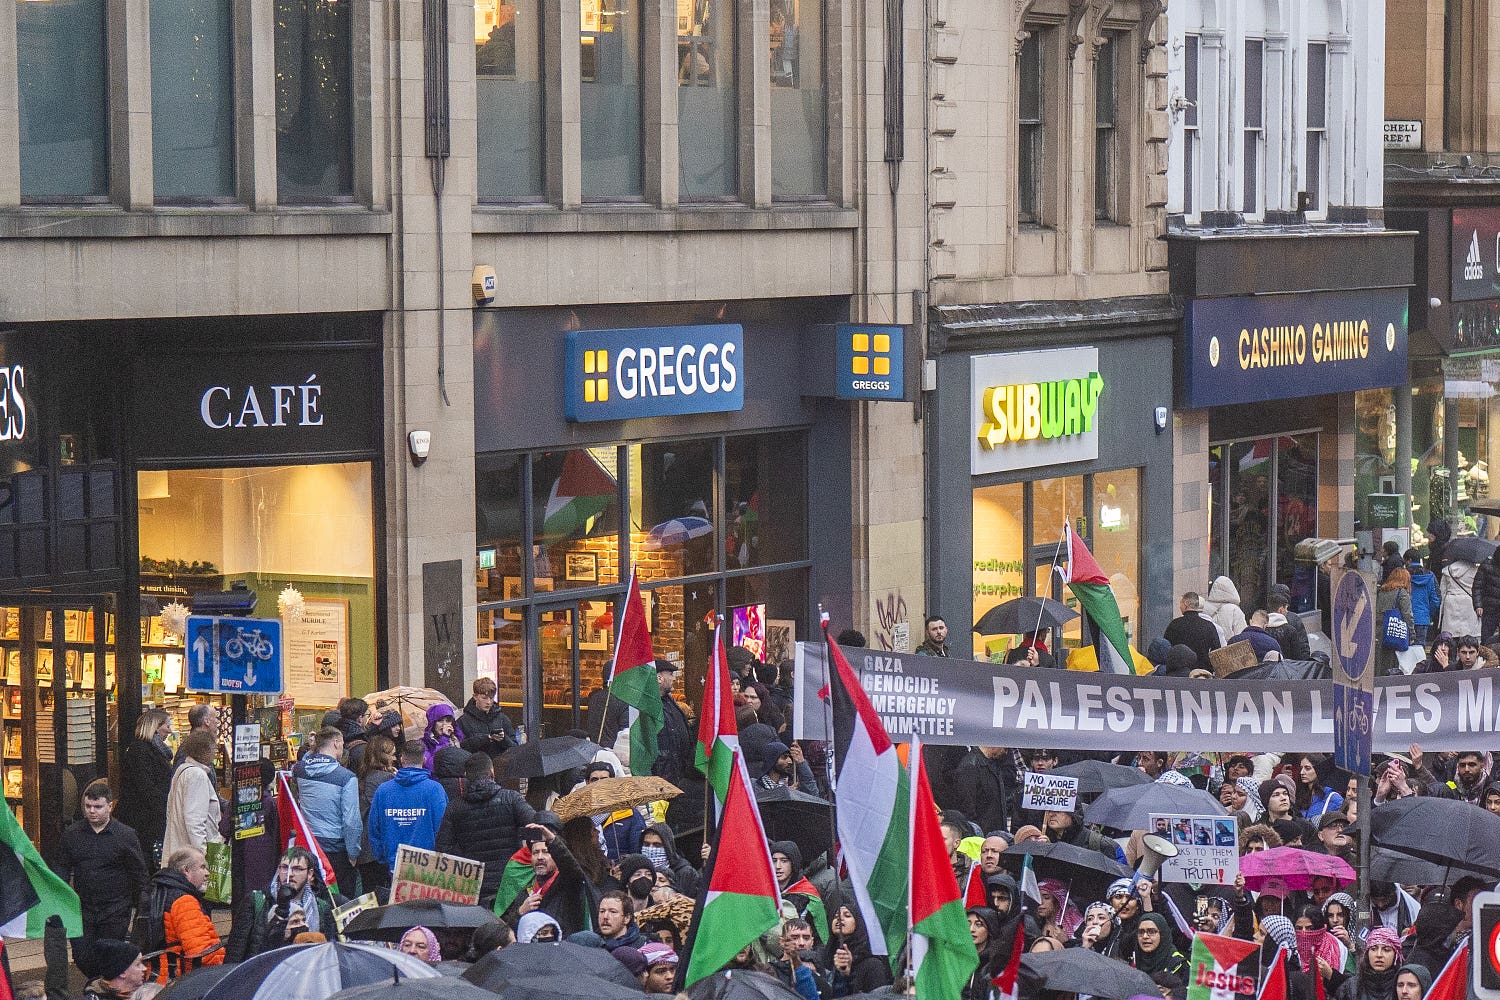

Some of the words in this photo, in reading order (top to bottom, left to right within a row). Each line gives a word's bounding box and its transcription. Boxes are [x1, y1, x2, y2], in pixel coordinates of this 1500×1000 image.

[1464, 261, 1483, 281] adidas
[1238, 324, 1307, 370] CASHINO
[1312, 319, 1369, 363] GAMING
[616, 342, 737, 400] GREGGS
[852, 380, 890, 391] GREGGS
[201, 374, 324, 429] CAFÉ
[978, 371, 1104, 450] SUBWAY
[163, 585, 188, 595] thinking
[863, 655, 904, 673] GAZA
[864, 674, 939, 695] GENOCIDE
[992, 676, 1294, 735] PALESTINIAN
[1310, 683, 1441, 735] LES
[878, 716, 955, 737] MMITTEE
[237, 777, 261, 788] BEFORE
[1024, 784, 1077, 798] INDIGENOUS
[1029, 775, 1044, 785] NO
[1048, 779, 1075, 789] MORE
[238, 803, 250, 813] STEP
[1031, 795, 1069, 806] ERASURE
[1195, 848, 1207, 856] TO
[1212, 848, 1233, 856] THEM
[402, 849, 429, 866] THIS
[435, 856, 448, 872] IS
[453, 858, 483, 880] NOT
[1214, 858, 1230, 866] THE
[1180, 867, 1225, 883] TRUTH!
[1195, 961, 1255, 996] Jesus
